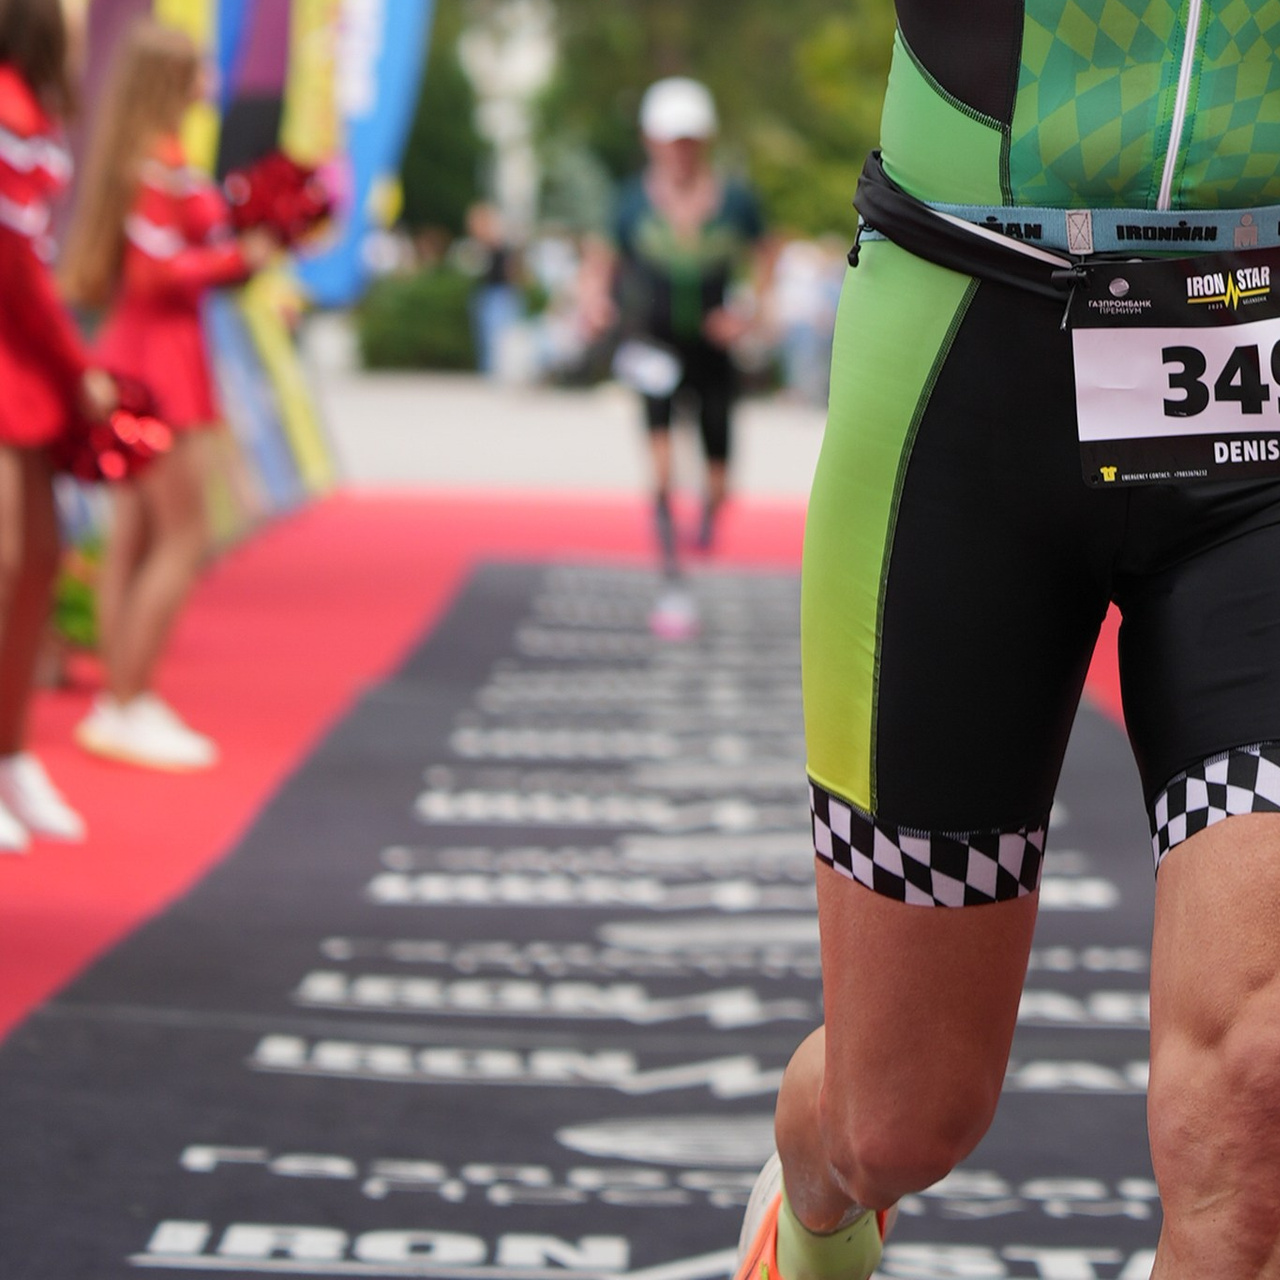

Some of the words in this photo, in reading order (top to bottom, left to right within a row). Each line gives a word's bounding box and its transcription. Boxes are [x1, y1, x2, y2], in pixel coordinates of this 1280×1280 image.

[1116, 220, 1218, 242] IRONMAN
[1187, 272, 1226, 297] IRON
[1236, 266, 1271, 290] STAR
[1088, 300, 1152, 308] ГАЗПРОМБАНК
[1213, 439, 1280, 464] DENIS
[147, 1220, 630, 1271] IRON
